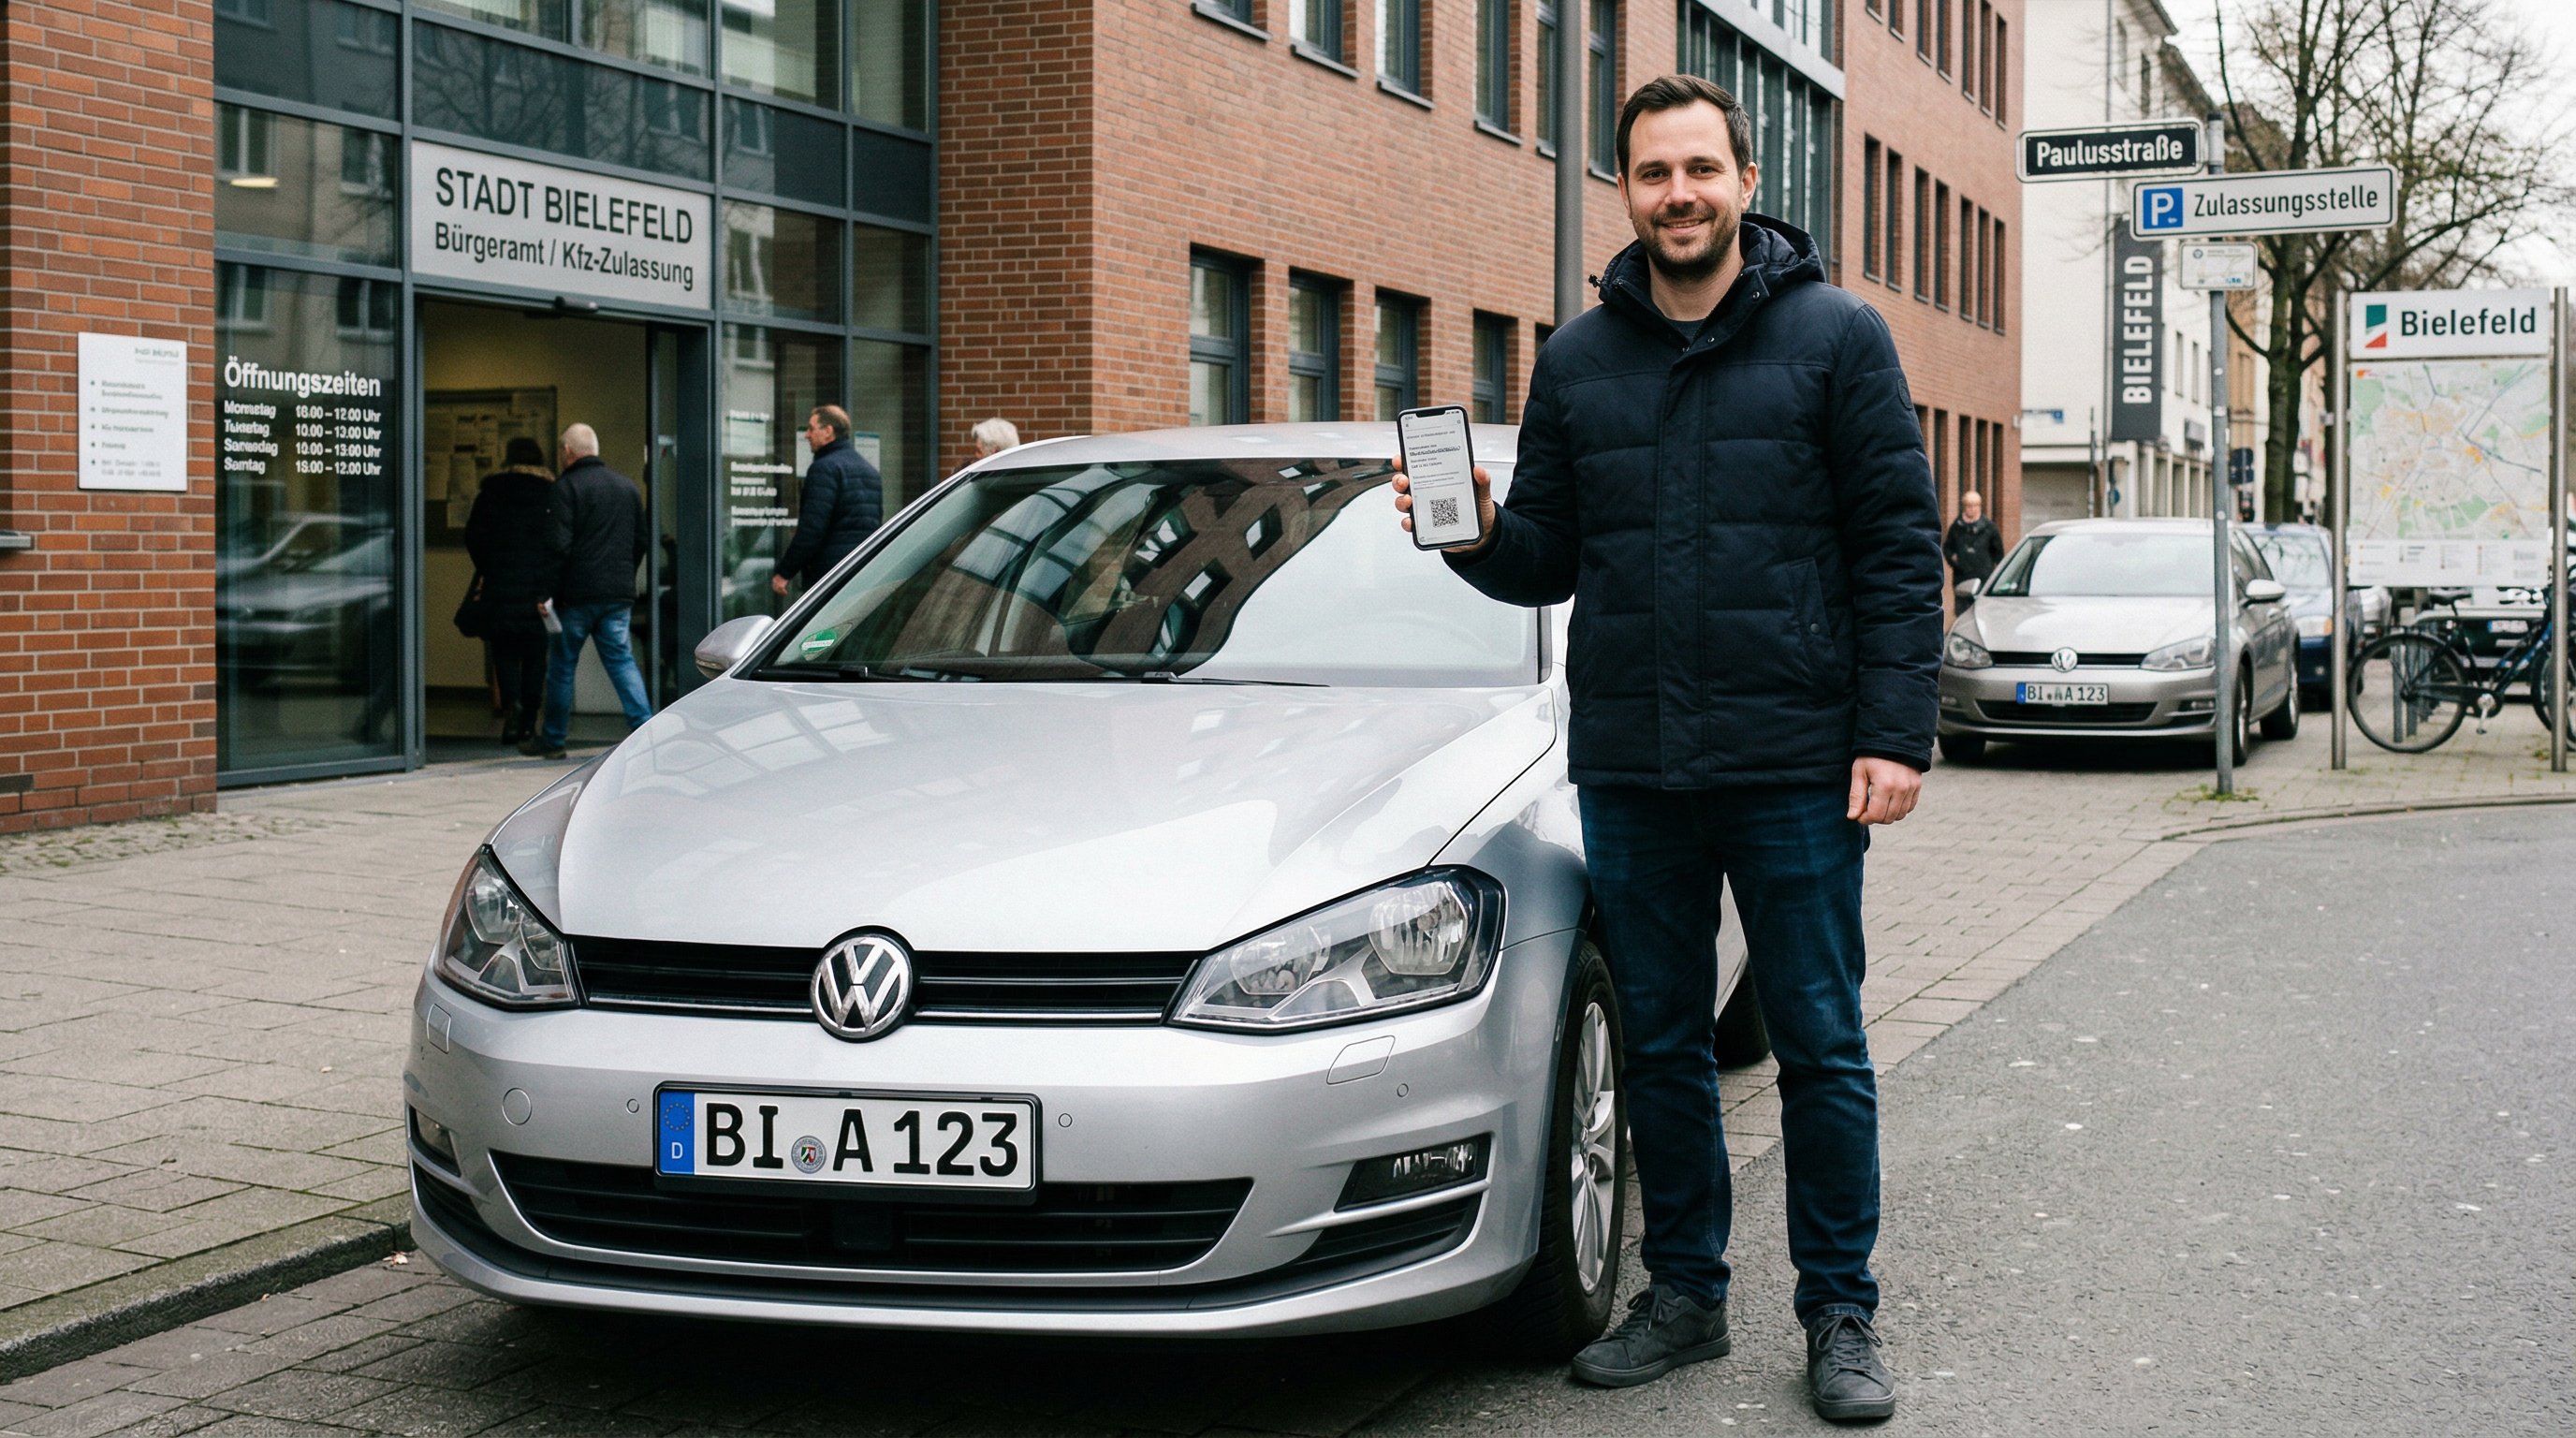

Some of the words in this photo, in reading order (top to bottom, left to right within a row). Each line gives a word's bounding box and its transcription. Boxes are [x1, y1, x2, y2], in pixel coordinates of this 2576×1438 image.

[2036, 134, 2184, 168] Paulusstraße
[435, 167, 534, 219] STADT
[545, 185, 693, 244] BIELEFELD
[2151, 192, 2174, 226] P
[2193, 184, 2379, 219] Zulassungsstelle
[434, 221, 545, 263] Bürgeramt
[549, 239, 557, 266] /
[563, 241, 694, 292] Kfz-Zulassung
[2122, 256, 2153, 404] BIELEFELD
[2401, 306, 2537, 337] Bielefeld
[224, 355, 381, 399] Öffnungszeiten
[362, 409, 382, 422] Uhr
[362, 427, 382, 440] Uhr
[362, 445, 382, 459] Uhr
[362, 462, 382, 476] Uhr
[2027, 685, 2043, 701] BI
[2077, 686, 2105, 701] 123
[812, 936, 911, 1036] VW
[670, 1141, 684, 1160] D
[705, 1101, 784, 1169] BI
[832, 1108, 874, 1173] A
[892, 1109, 1019, 1178] 123
